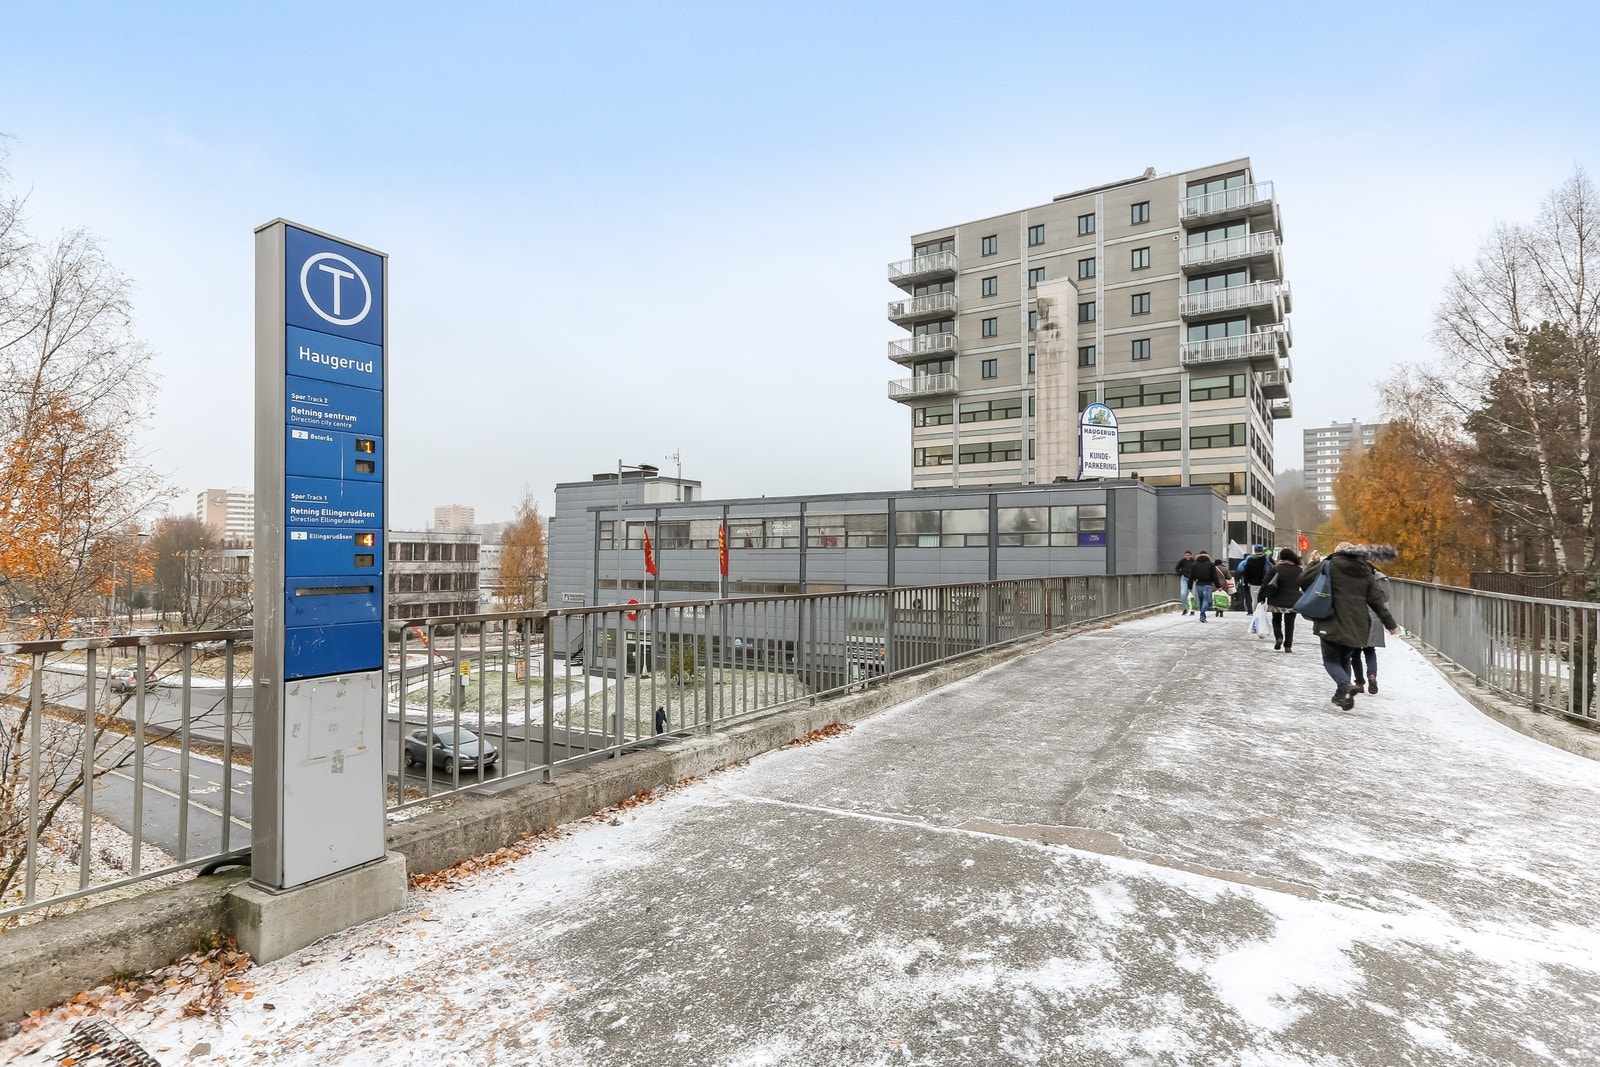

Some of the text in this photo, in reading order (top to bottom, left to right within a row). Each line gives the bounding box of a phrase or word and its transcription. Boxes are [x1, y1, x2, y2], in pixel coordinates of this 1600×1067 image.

[318, 264, 354, 316] T
[299, 346, 373, 374] Haugerud
[291, 392, 306, 401] Spor
[307, 395, 323, 403] Track
[290, 406, 357, 422] Retning sentrum
[291, 416, 353, 429] Direction city centre
[1084, 428, 1116, 436] HAUGERUD
[365, 441, 372, 453] 1
[1090, 452, 1112, 460] KUNDE-
[1085, 462, 1117, 470] PARKERING
[307, 493, 323, 501] Track
[290, 507, 375, 518] Retning Ellingsrudåsen
[320, 516, 365, 525] Ellingsrudåsen
[363, 533, 373, 547] 4
